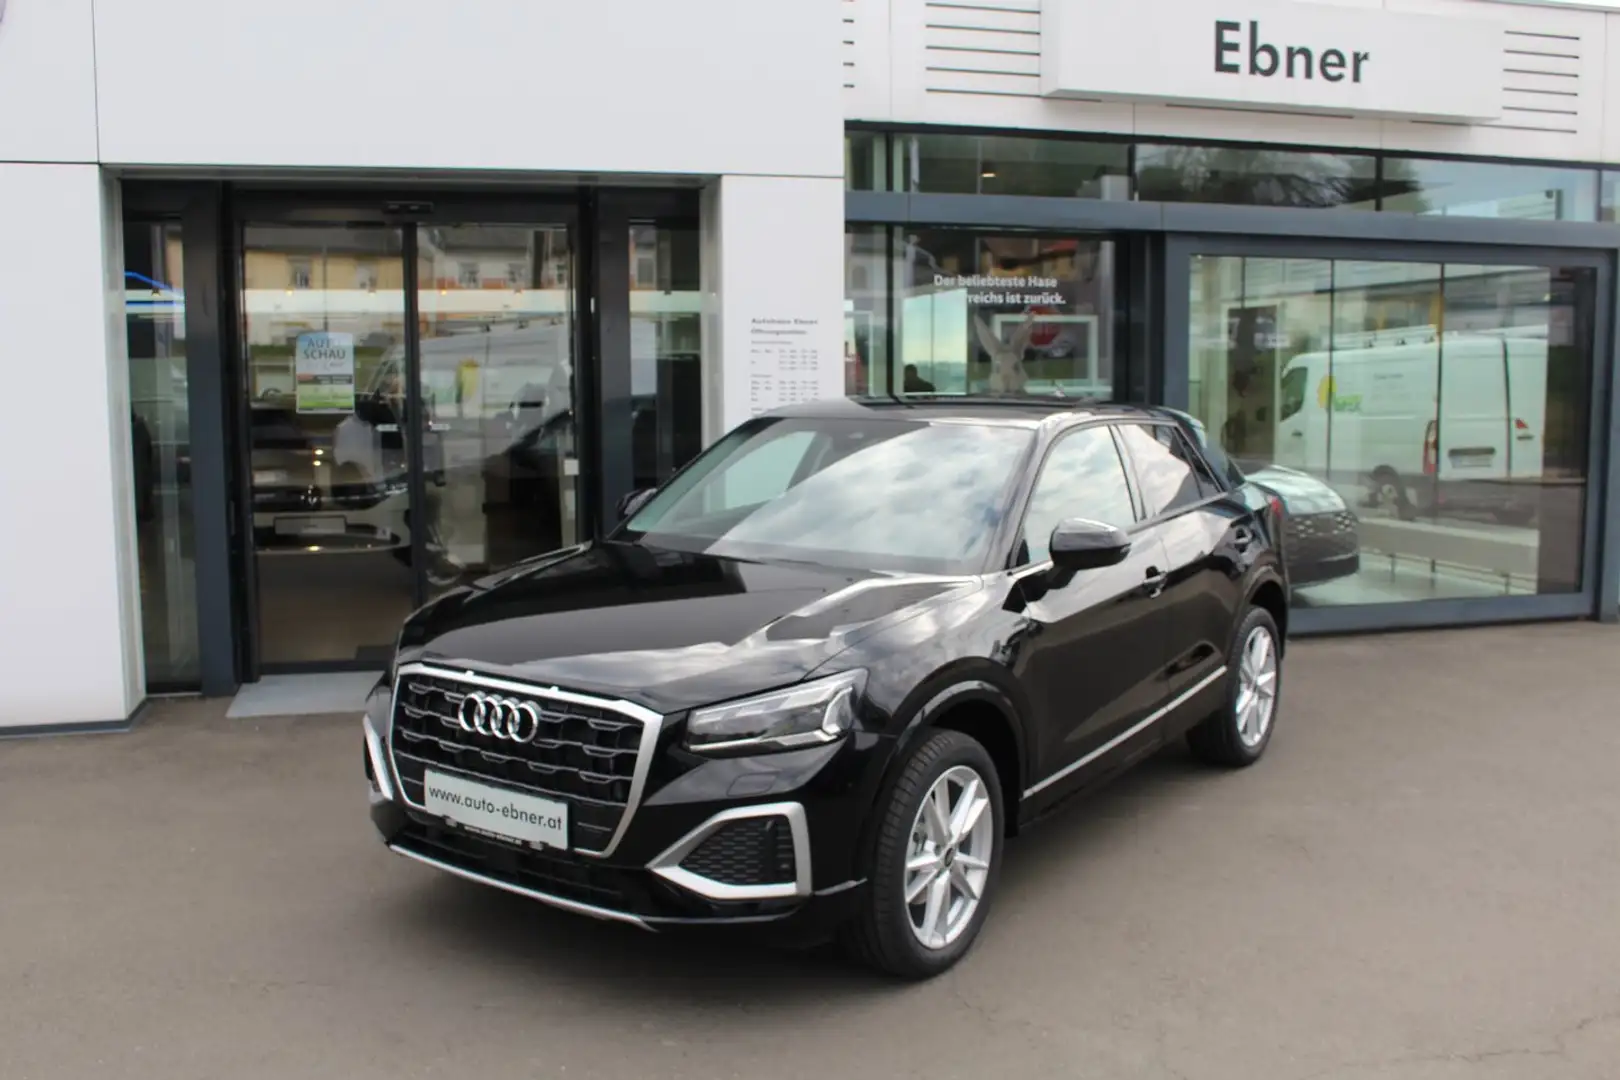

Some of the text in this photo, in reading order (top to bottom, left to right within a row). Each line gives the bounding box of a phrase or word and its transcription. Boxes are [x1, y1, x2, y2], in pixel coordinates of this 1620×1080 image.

[1215, 20, 1370, 84] Ebner
[934, 274, 1058, 288] Der beliebteste Hase
[1005, 291, 1022, 304] ist
[1023, 292, 1067, 305] zurück.
[303, 348, 347, 360] SCHAU
[428, 786, 562, 831] www.auto-ebner.at
